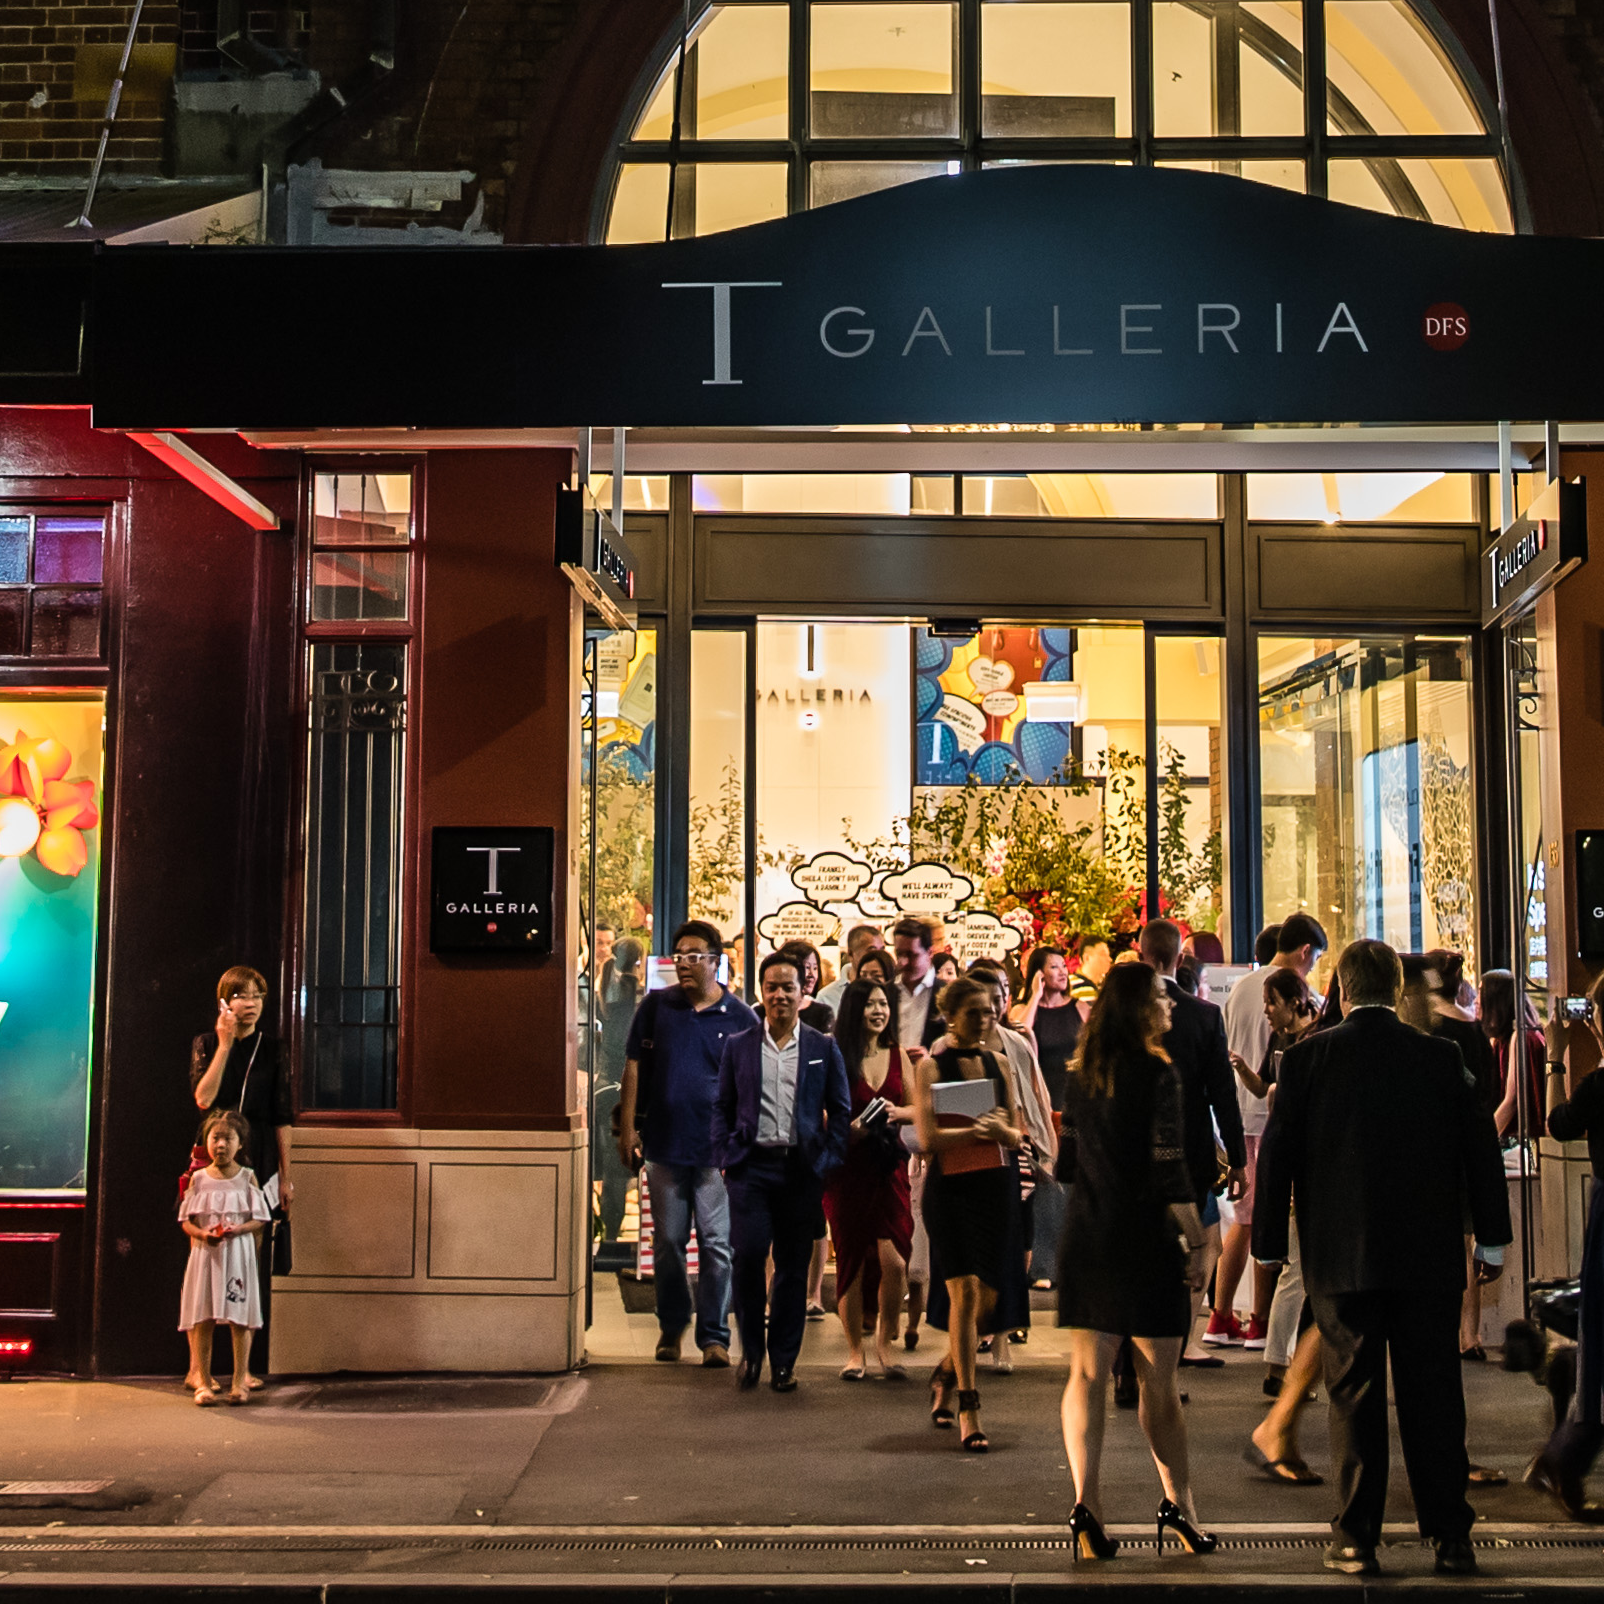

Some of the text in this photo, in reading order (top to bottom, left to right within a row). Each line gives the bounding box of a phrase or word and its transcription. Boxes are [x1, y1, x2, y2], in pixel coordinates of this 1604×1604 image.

[661, 281, 1467, 385] T GALLERIA DFS
[1489, 530, 1537, 609] T GALLERIA
[466, 847, 521, 895] T
[901, 891, 919, 899] HAVE
[923, 882, 954, 890] ALWAYS
[446, 903, 539, 914] GALLERIA
